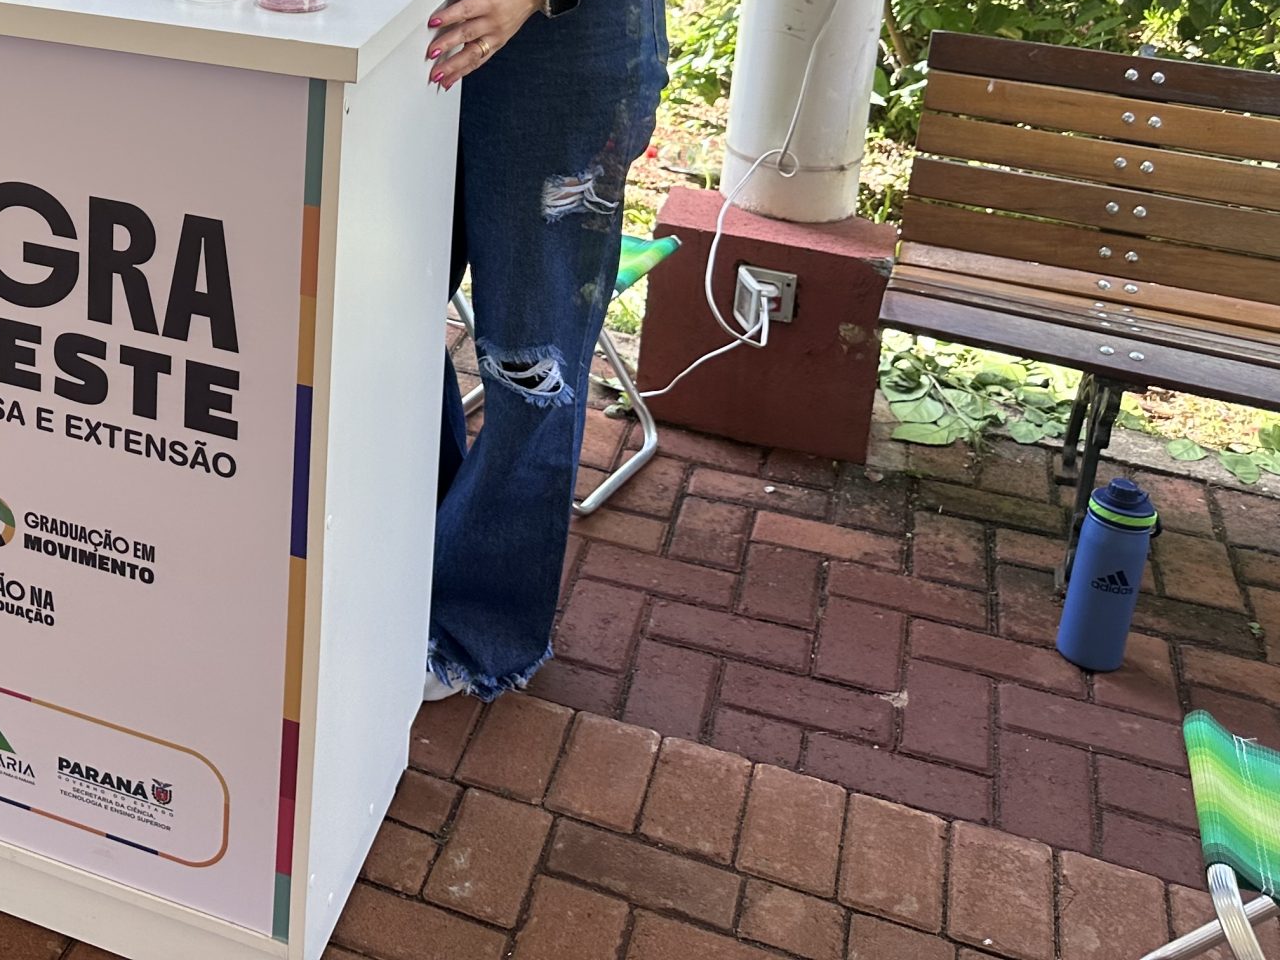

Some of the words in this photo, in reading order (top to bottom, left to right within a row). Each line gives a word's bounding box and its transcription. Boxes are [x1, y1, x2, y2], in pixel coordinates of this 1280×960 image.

[35, 408, 54, 433] E
[65, 414, 237, 479] EXTENSÃO
[24, 511, 129, 554] GRADUAÇÃO
[133, 541, 156, 563] EM
[23, 533, 155, 585] MOVIMENTO
[30, 585, 55, 612] NA
[1091, 580, 1133, 595] adidas
[58, 756, 148, 800] PARANÁ
[58, 775, 105, 794] GOVERNO
[133, 800, 174, 818] ESTADO
[72, 786, 113, 805] SECRETARIA
[115, 801, 125, 810] DA
[60, 789, 103, 809] TECNOLOGIA
[110, 806, 135, 819] ENSINO
[137, 815, 171, 831] SUPERIOR
